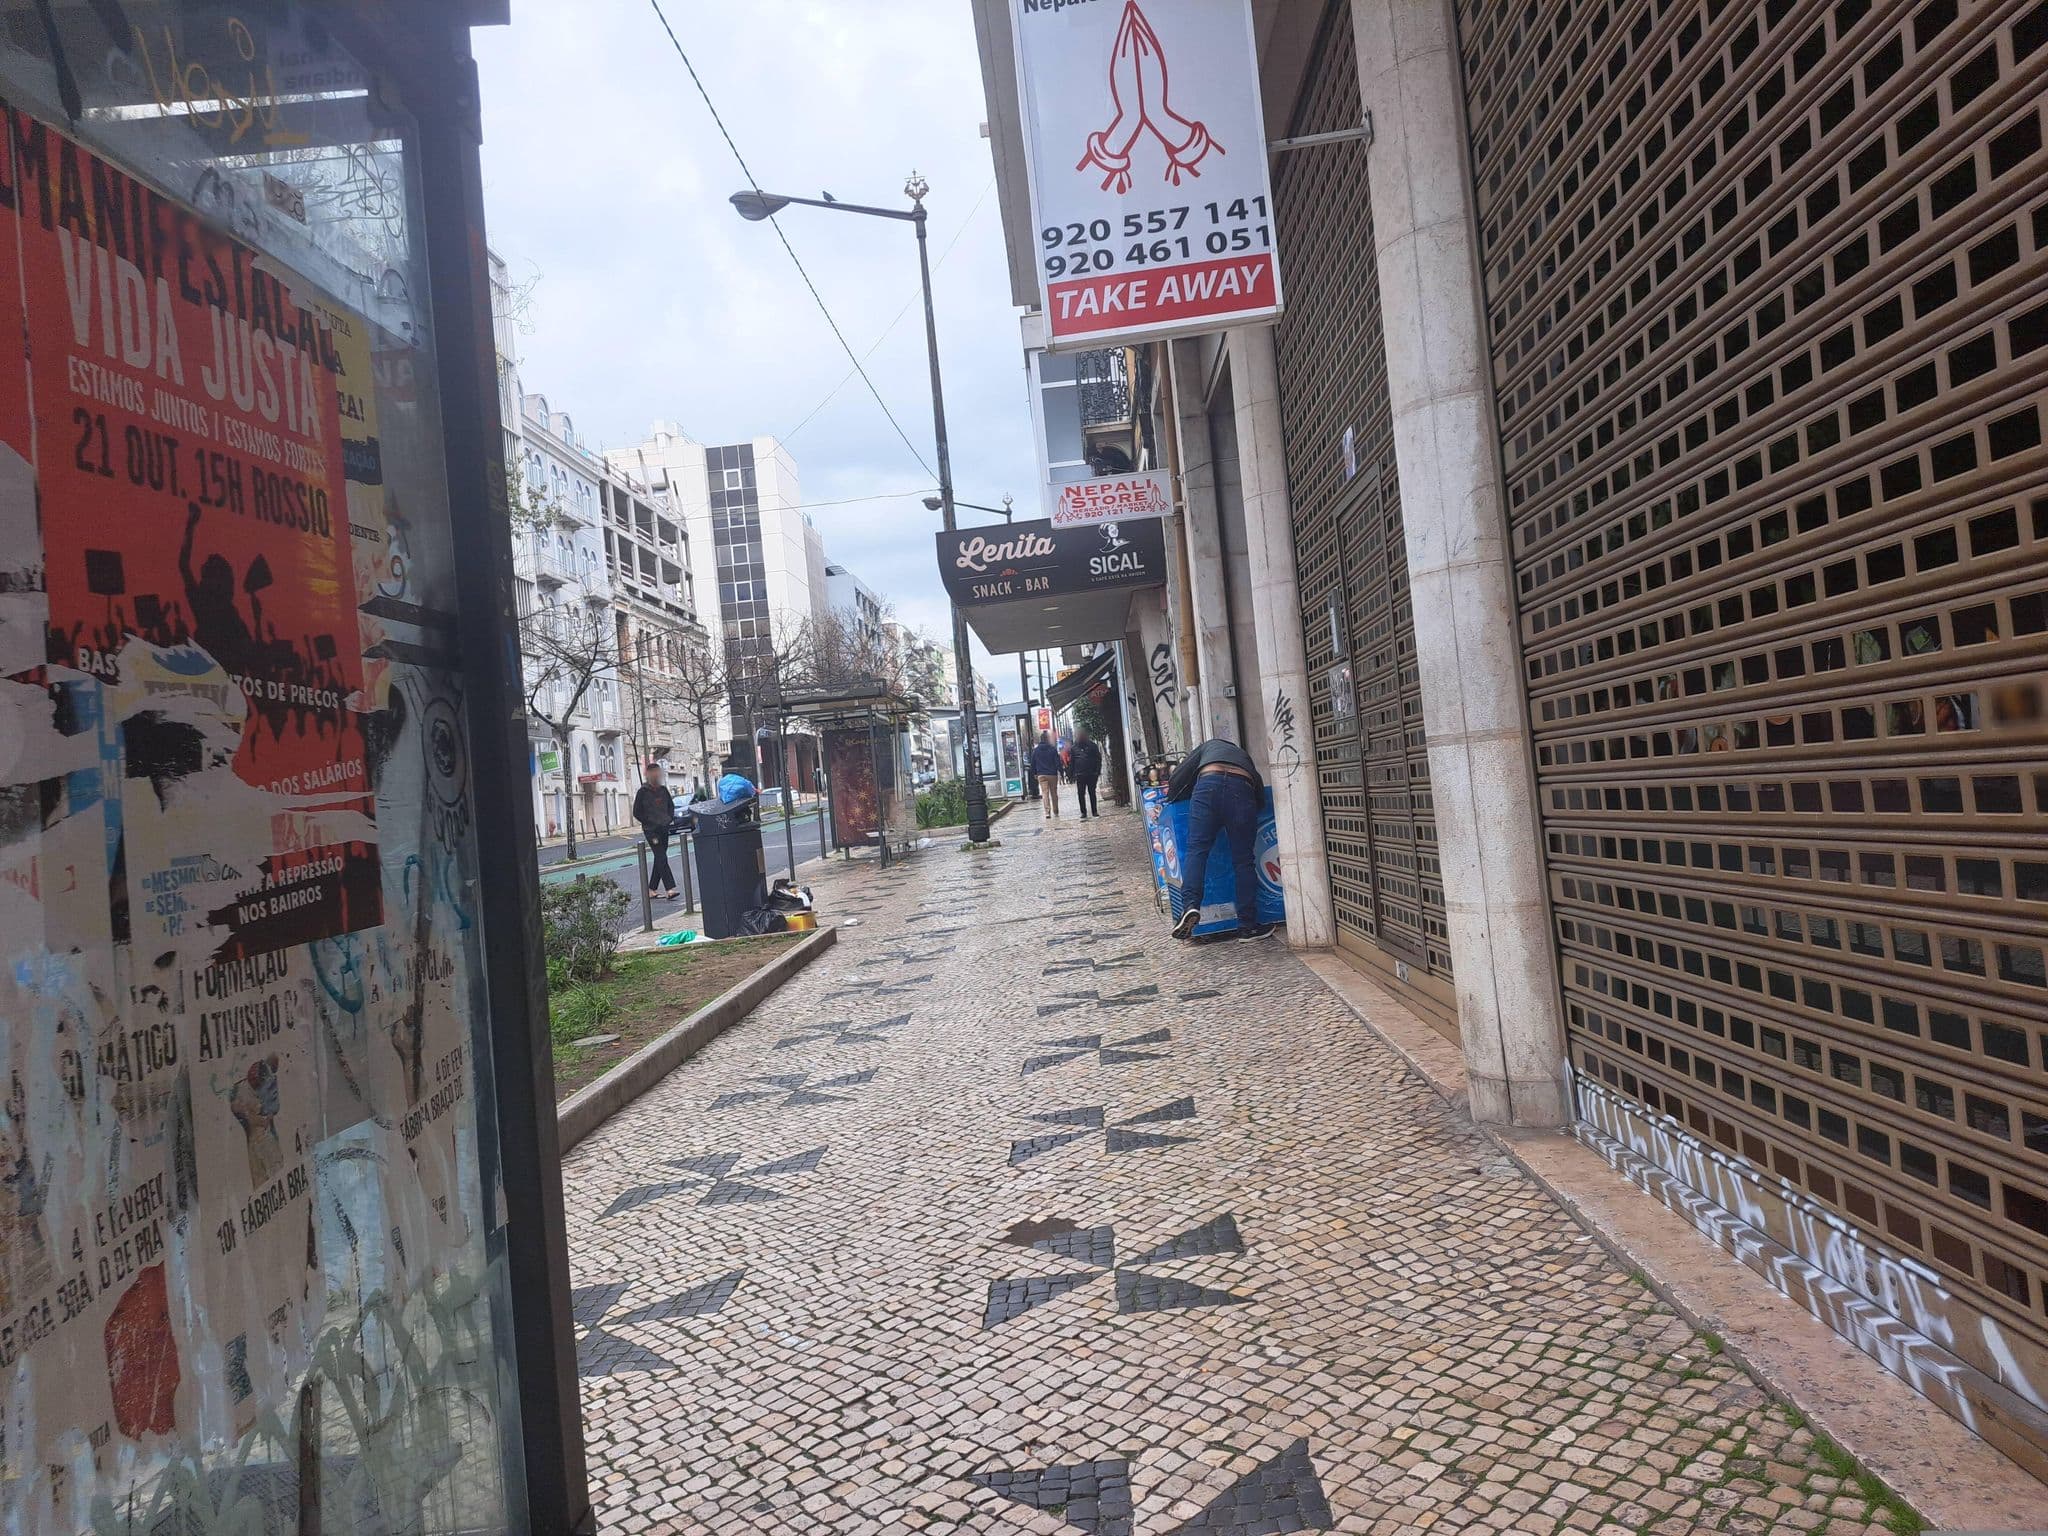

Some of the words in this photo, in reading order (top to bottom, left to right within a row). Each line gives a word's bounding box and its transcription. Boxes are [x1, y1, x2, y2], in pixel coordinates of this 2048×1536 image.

[1042, 219, 1111, 250] 920
[1124, 207, 1190, 237] 557
[1204, 196, 1268, 225] 141
[1045, 250, 1114, 279] 920
[1125, 236, 1190, 265] 461
[1205, 225, 1270, 254] 051
[1055, 280, 1147, 319] TAKE
[1156, 263, 1264, 306] AWAY
[57, 224, 184, 386] VIDA
[201, 303, 322, 443] JUSTA
[68, 355, 145, 417] ESTAMOS
[151, 387, 210, 442] JUNTOS
[224, 415, 281, 464] ESTAMOS
[72, 406, 116, 479] 21
[124, 424, 188, 500] OUT.
[194, 447, 245, 516] 15H
[250, 464, 331, 539] ROSSIO
[1065, 479, 1151, 498] NEPALI
[1071, 491, 1148, 508] STORE
[1085, 509, 1103, 518] 920
[956, 533, 1057, 572] Lenita
[1089, 551, 1145, 575] SICAL
[972, 580, 1012, 600] SNACK
[1026, 577, 1050, 592] BAR
[267, 680, 287, 703] DE
[290, 684, 340, 713] PREÇOS
[304, 759, 363, 791] SALÁRIOS
[277, 852, 344, 887] REPRESSÃO
[238, 900, 267, 925] NOS
[271, 885, 322, 915] BAIRROS
[199, 994, 282, 1063] ATIVISMO
[240, 1178, 288, 1239] FÁBRICA
